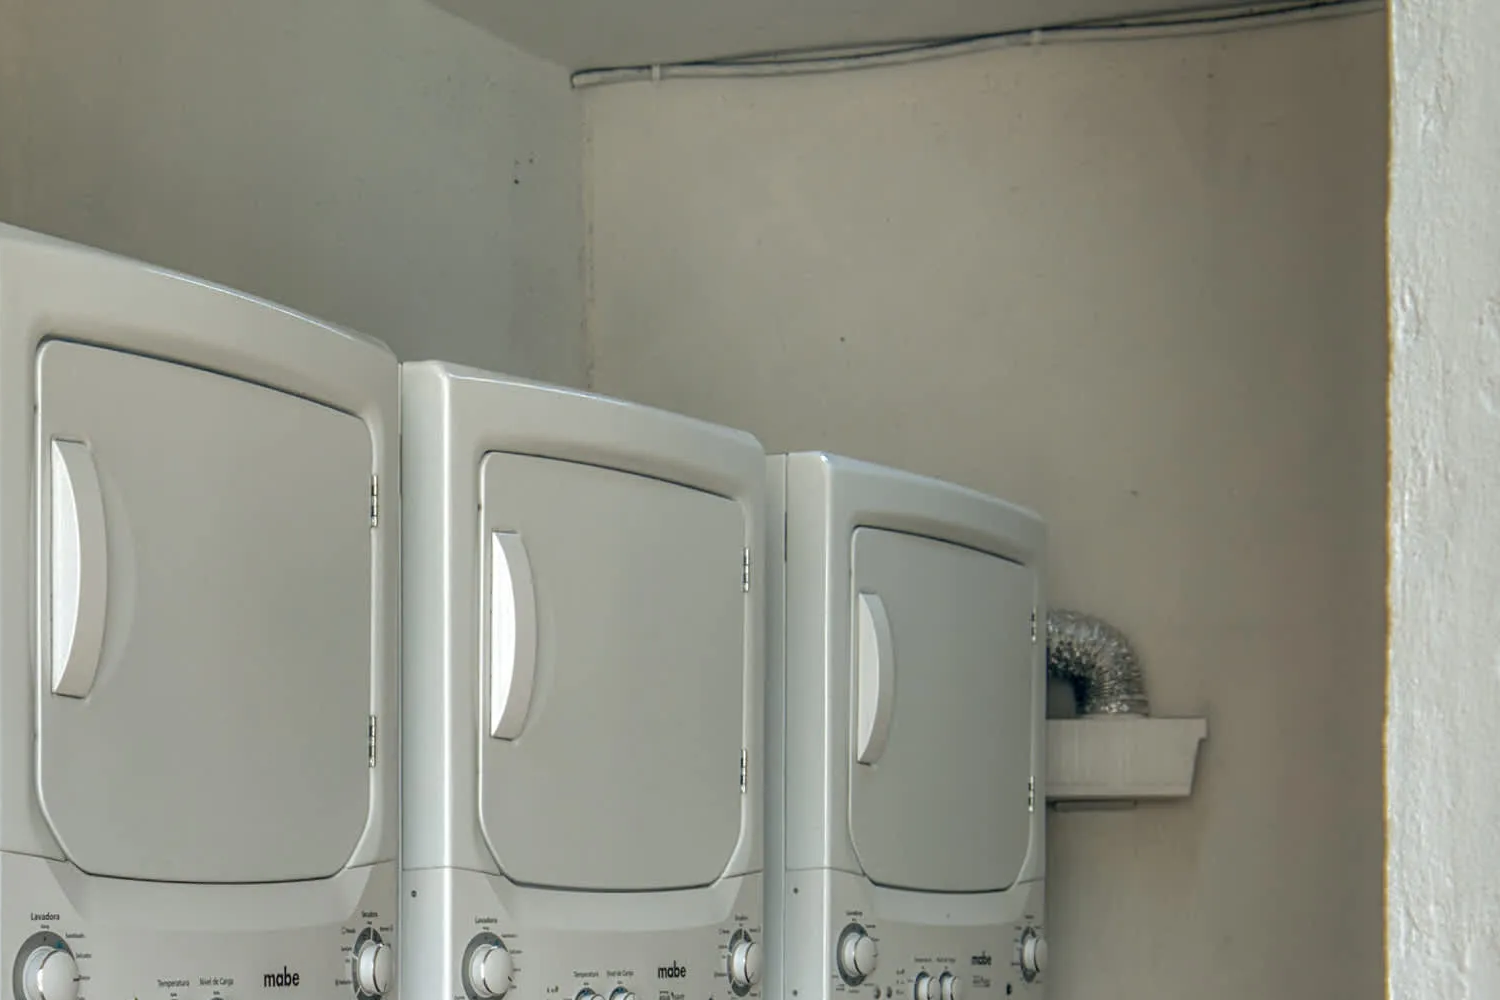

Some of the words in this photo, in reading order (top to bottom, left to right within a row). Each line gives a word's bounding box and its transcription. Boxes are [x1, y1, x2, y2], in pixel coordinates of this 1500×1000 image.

[30, 911, 60, 922] Lavadora
[657, 959, 687, 979] mabe
[220, 977, 234, 987] Carga
[263, 965, 300, 988] mabe
[157, 979, 190, 988] Temperatura
